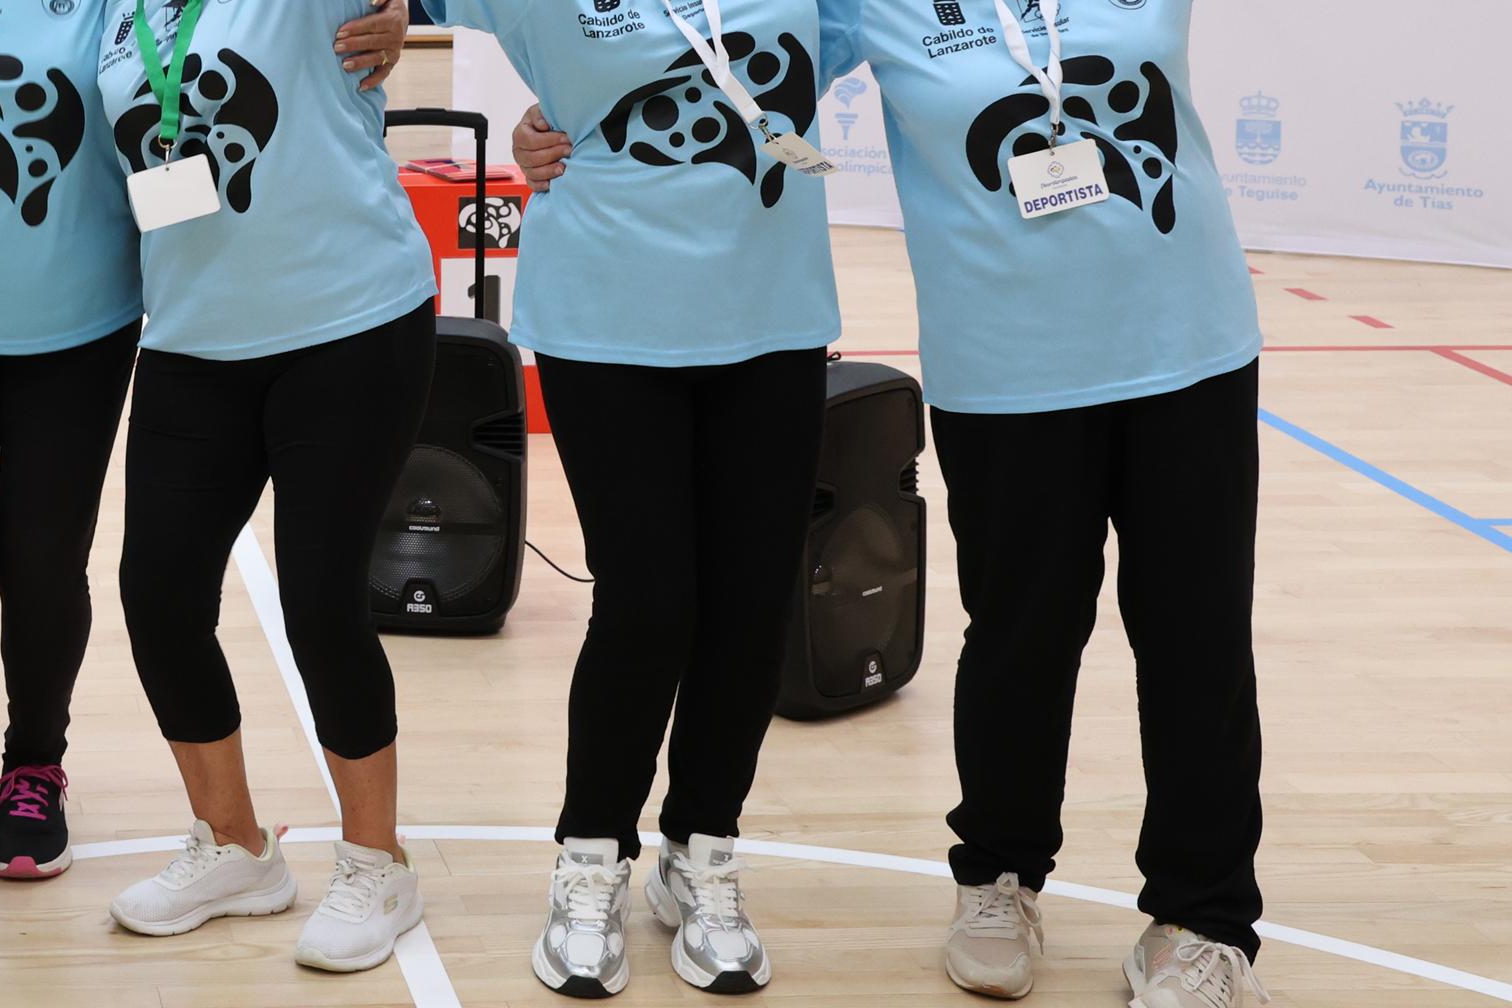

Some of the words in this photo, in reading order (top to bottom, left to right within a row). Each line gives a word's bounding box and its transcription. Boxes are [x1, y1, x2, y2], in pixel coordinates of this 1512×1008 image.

[577, 13, 625, 27] Cabildo
[627, 8, 641, 20] de
[582, 21, 646, 39] Lanzarote
[922, 28, 974, 47] Cabildo
[977, 26, 994, 35] de
[927, 35, 997, 59] Lanzarote
[821, 145, 887, 160] sociación
[1220, 173, 1308, 189] yuntamiento
[1363, 178, 1485, 199] Ayuntamiento
[1023, 183, 1104, 214] DEPORTISTA
[1238, 185, 1300, 202] Teguise
[1393, 195, 1415, 208] de
